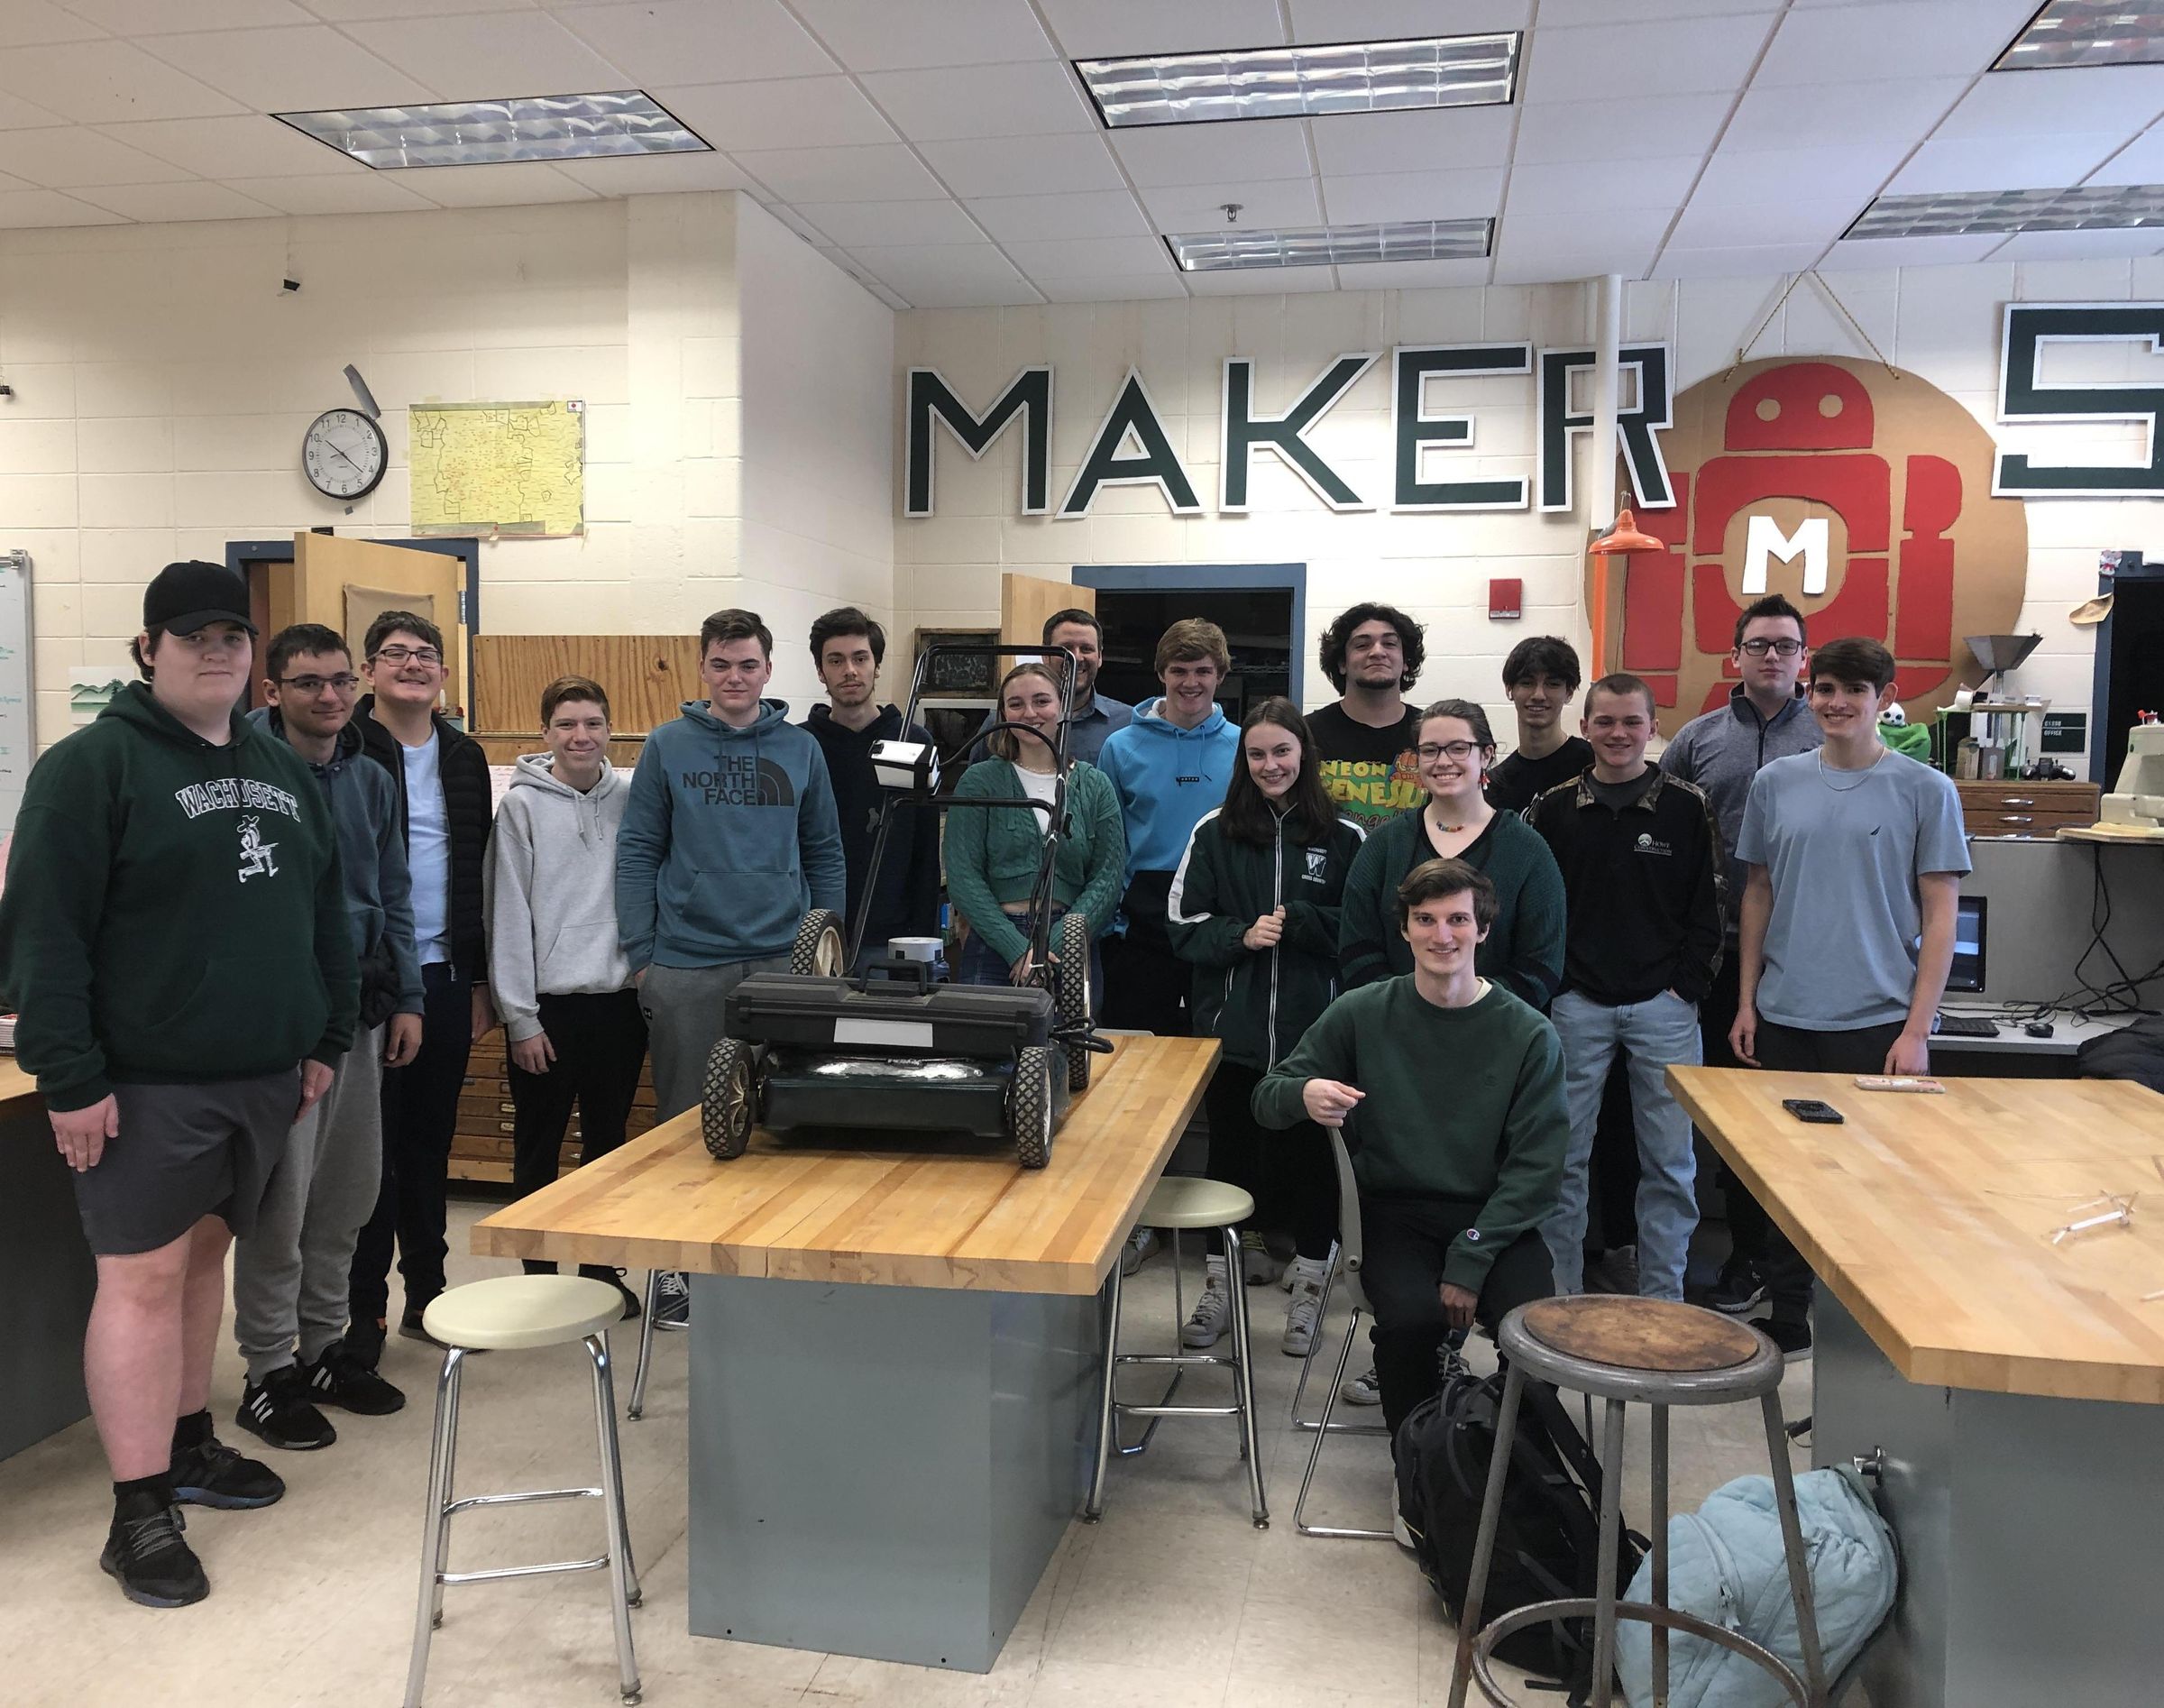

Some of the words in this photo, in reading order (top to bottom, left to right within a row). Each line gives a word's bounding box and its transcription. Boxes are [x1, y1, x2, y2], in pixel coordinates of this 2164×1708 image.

[336, 414, 346, 423] 12
[904, 340, 1678, 519] MAKER
[309, 433, 322, 443] 10
[308, 451, 315, 460] 9
[371, 446, 378, 456] 3
[313, 468, 319, 477] 8
[368, 464, 374, 473] 4
[325, 480, 331, 490] 7
[341, 483, 348, 493] 6
[357, 478, 363, 488] 5
[1741, 515, 1829, 594] M
[713, 755, 756, 772] THE
[1319, 759, 1387, 777] NEON
[682, 771, 756, 789] NORTH
[175, 777, 301, 823] WACHUSETT
[703, 788, 757, 806] FACE
